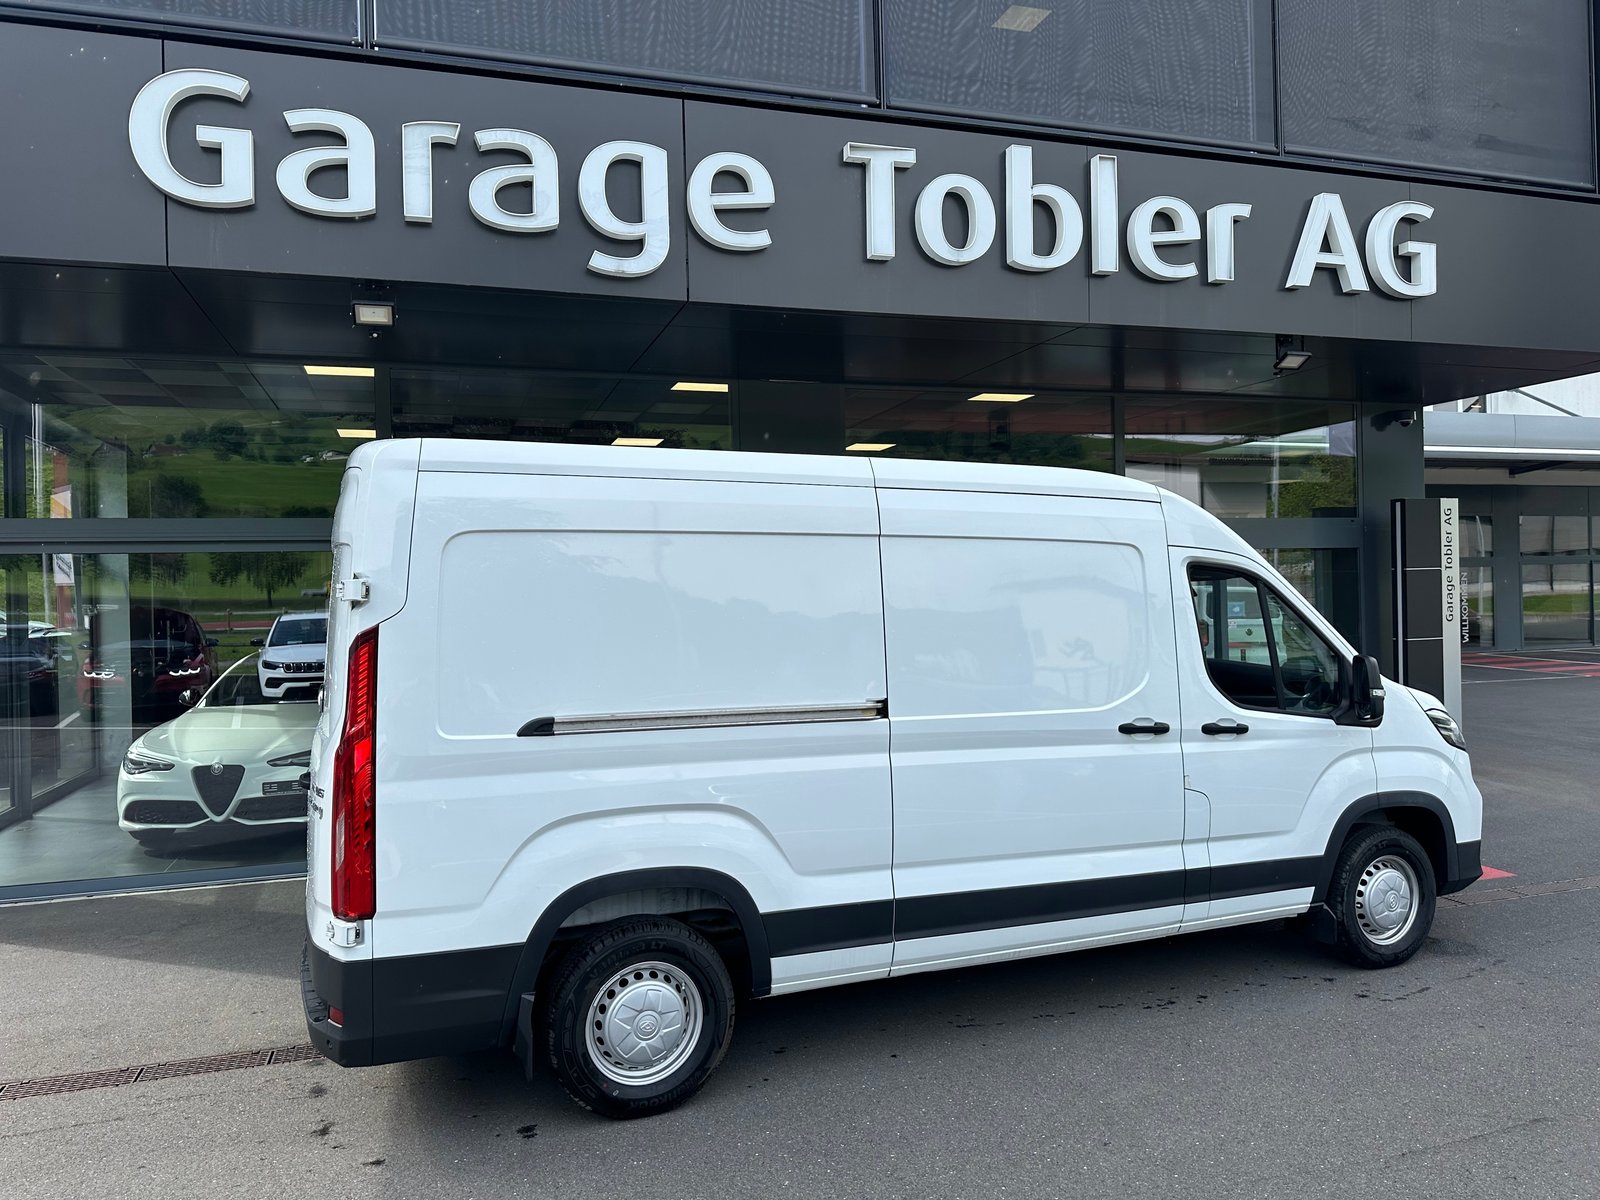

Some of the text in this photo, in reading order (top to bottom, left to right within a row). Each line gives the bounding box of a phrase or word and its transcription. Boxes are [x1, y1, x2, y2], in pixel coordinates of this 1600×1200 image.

[128, 68, 1438, 299] Garage Tobler AG
[1443, 507, 1456, 622] Garage Tobler AG
[1459, 572, 1470, 644] WILLKOMMEN
